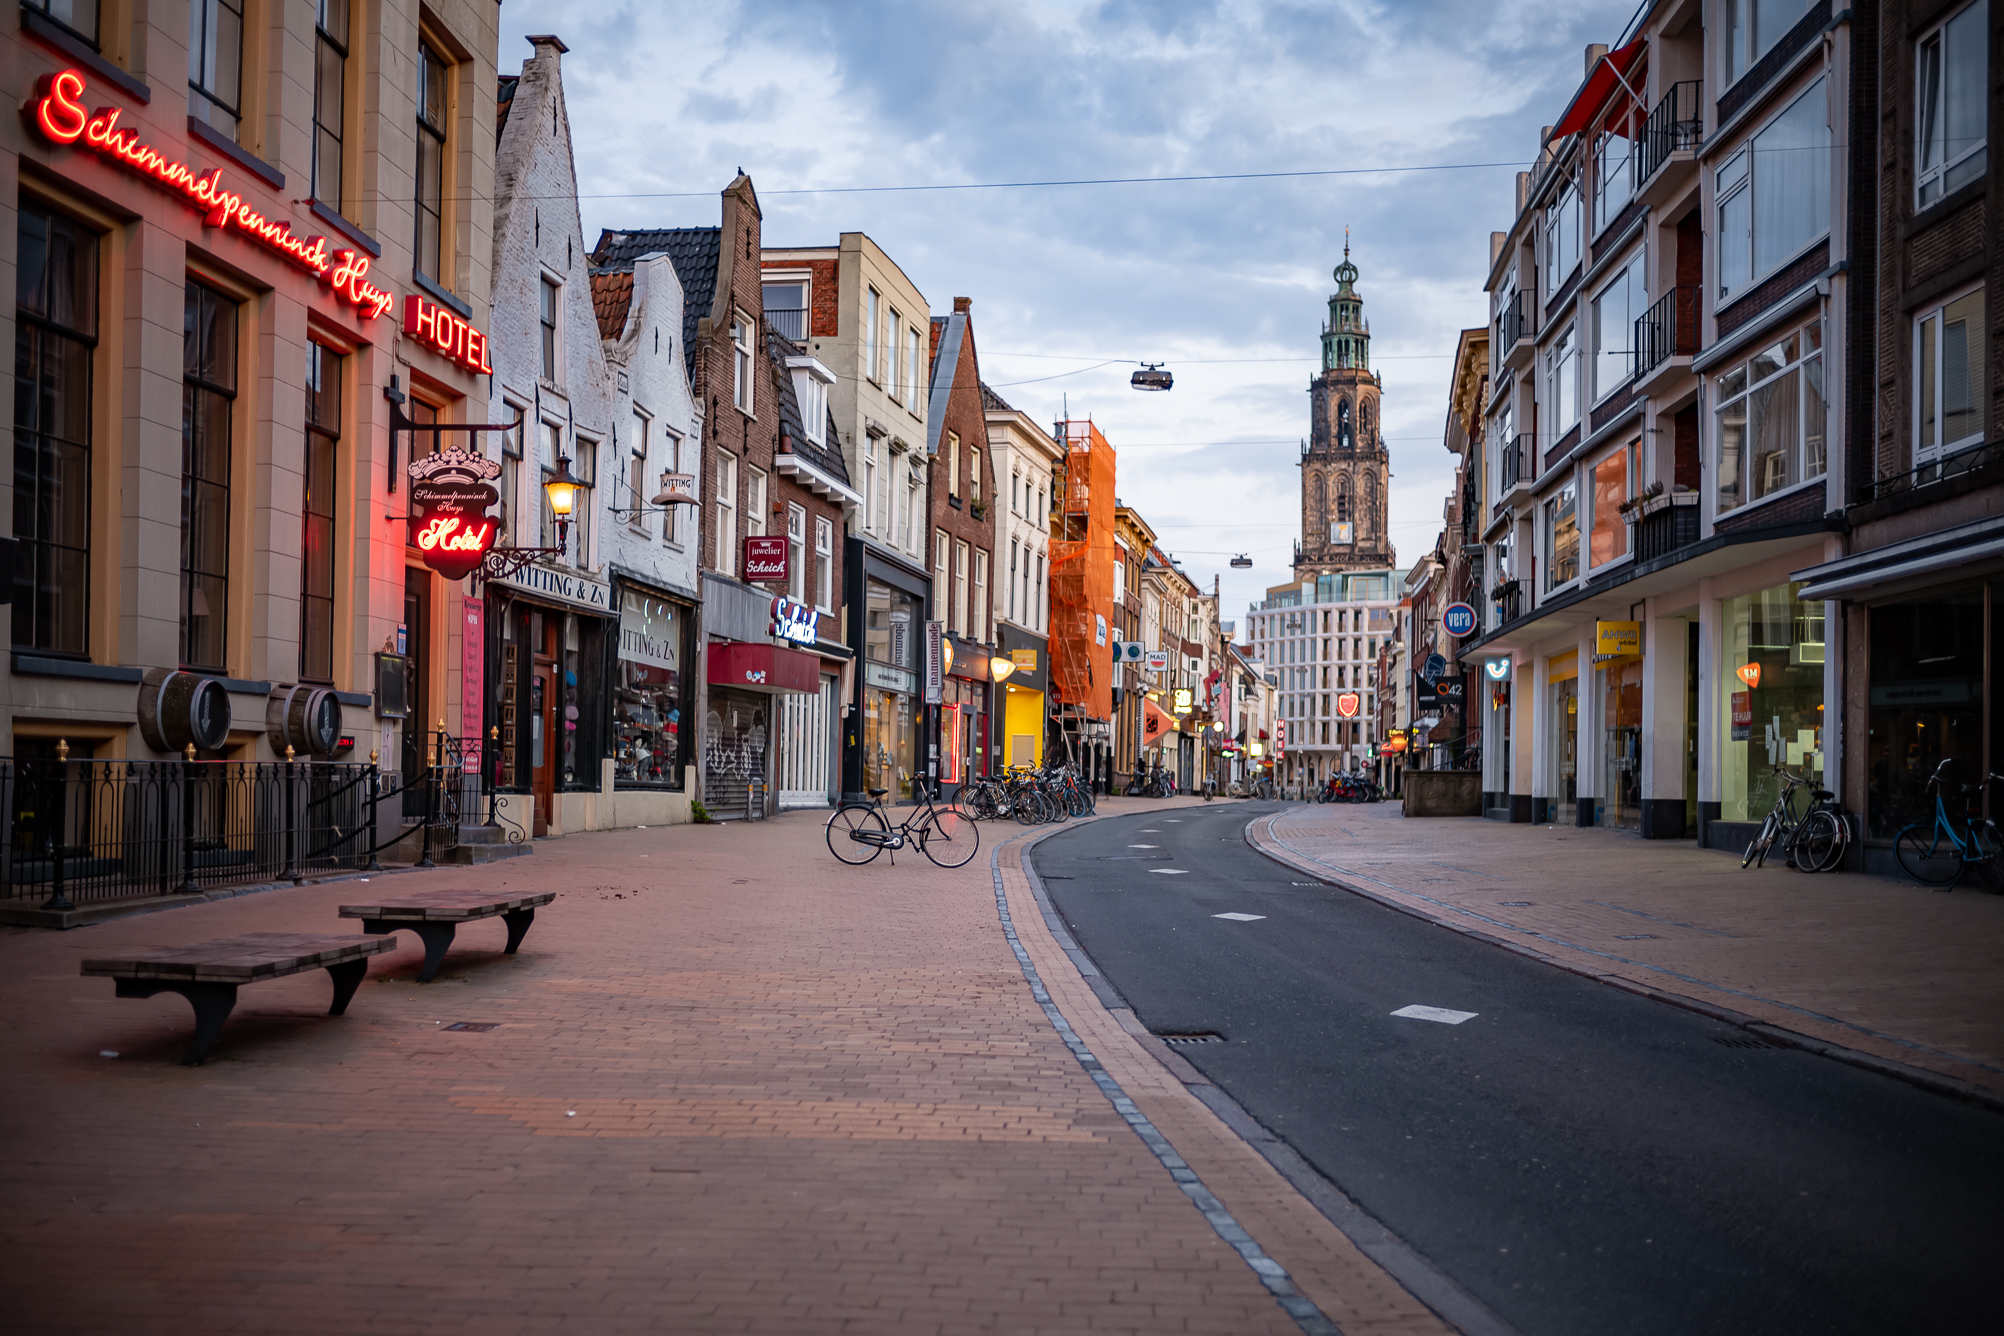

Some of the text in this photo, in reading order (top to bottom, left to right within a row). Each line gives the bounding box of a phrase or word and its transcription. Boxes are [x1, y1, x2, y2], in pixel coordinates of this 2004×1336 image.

[36, 67, 395, 321] Schimmelpenninck Huys
[416, 296, 493, 375] HOTEL
[661, 478, 691, 489] WITTING
[414, 489, 488, 504] Schimmelpenninck
[437, 501, 464, 515] Huys
[418, 517, 488, 551] Hotel
[751, 546, 782, 557] juwelier
[746, 559, 786, 574] Scheich
[514, 563, 573, 601] WITTING
[576, 581, 586, 601] &
[775, 597, 820, 646] Scheich
[1448, 612, 1471, 628] vera
[1601, 629, 1638, 640] ANWB
[929, 622, 939, 686] mannenmode
[1277, 719, 1285, 759] HOEK
